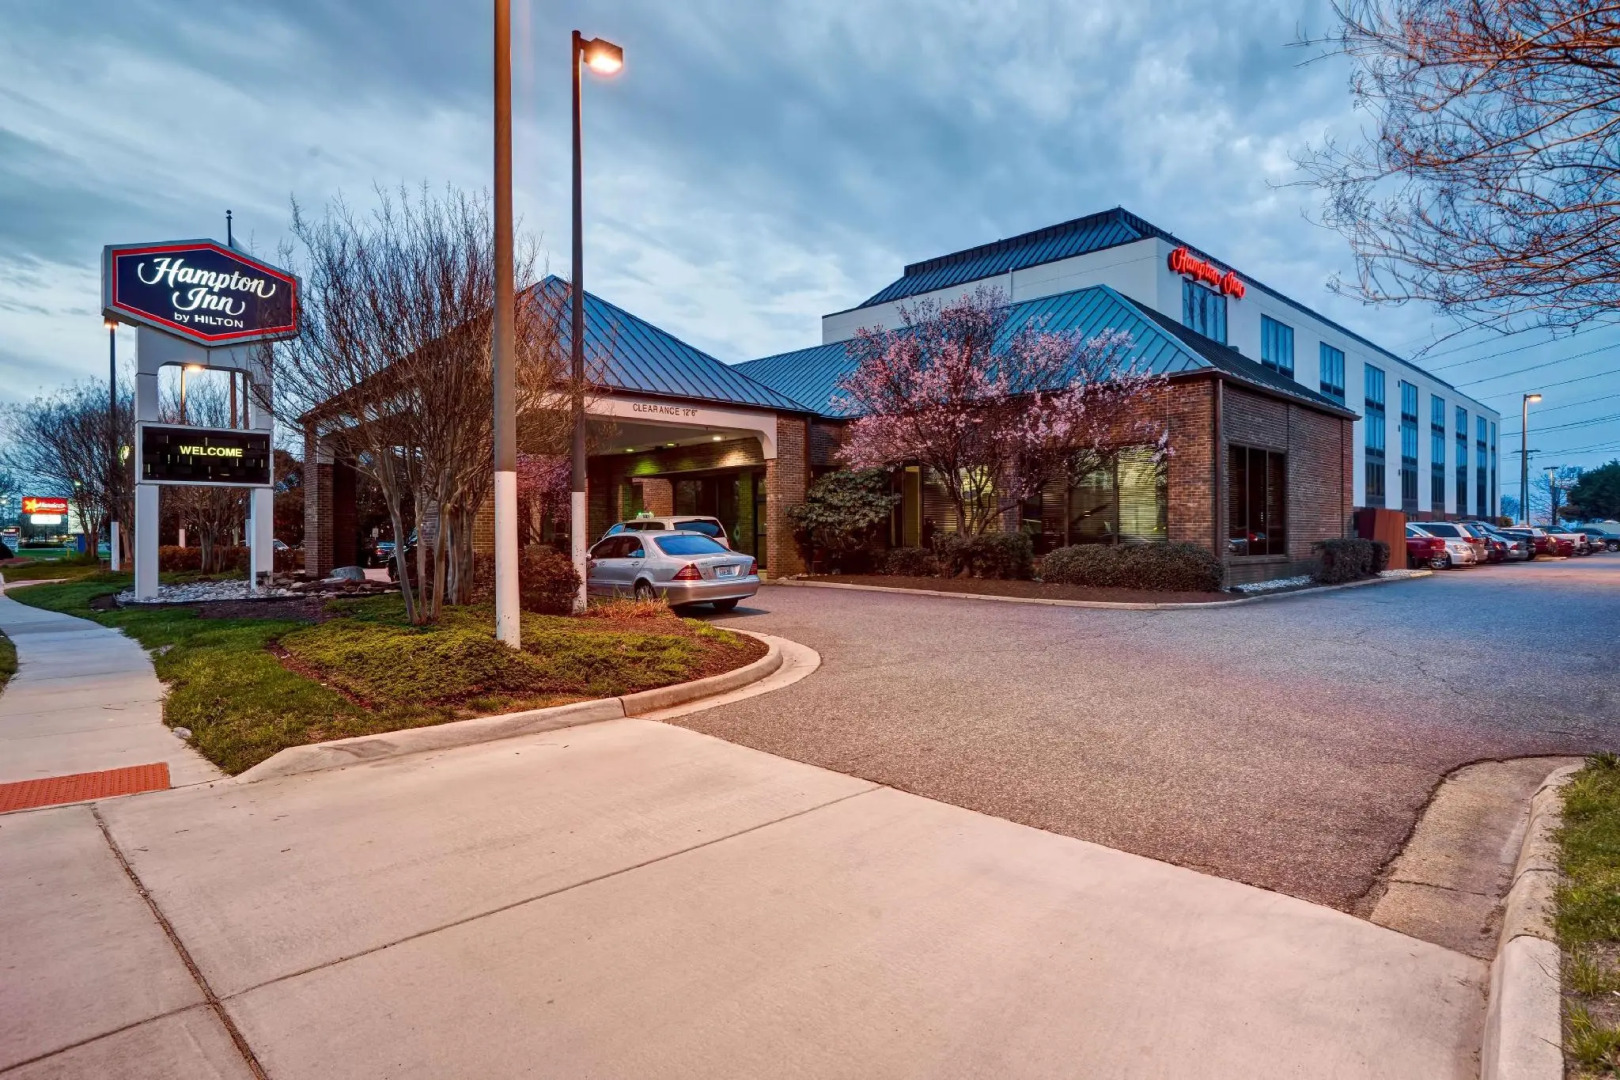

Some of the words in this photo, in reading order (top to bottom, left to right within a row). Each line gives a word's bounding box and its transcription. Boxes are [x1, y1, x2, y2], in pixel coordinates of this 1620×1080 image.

[137, 257, 275, 298] Hampton
[1168, 246, 1221, 286] Hampton
[1220, 271, 1246, 299] Inn
[172, 287, 245, 316] Inn
[174, 312, 190, 323] by
[194, 315, 244, 328] HILTON
[632, 403, 680, 416] CLEARANCE
[180, 445, 243, 458] WELCOME
